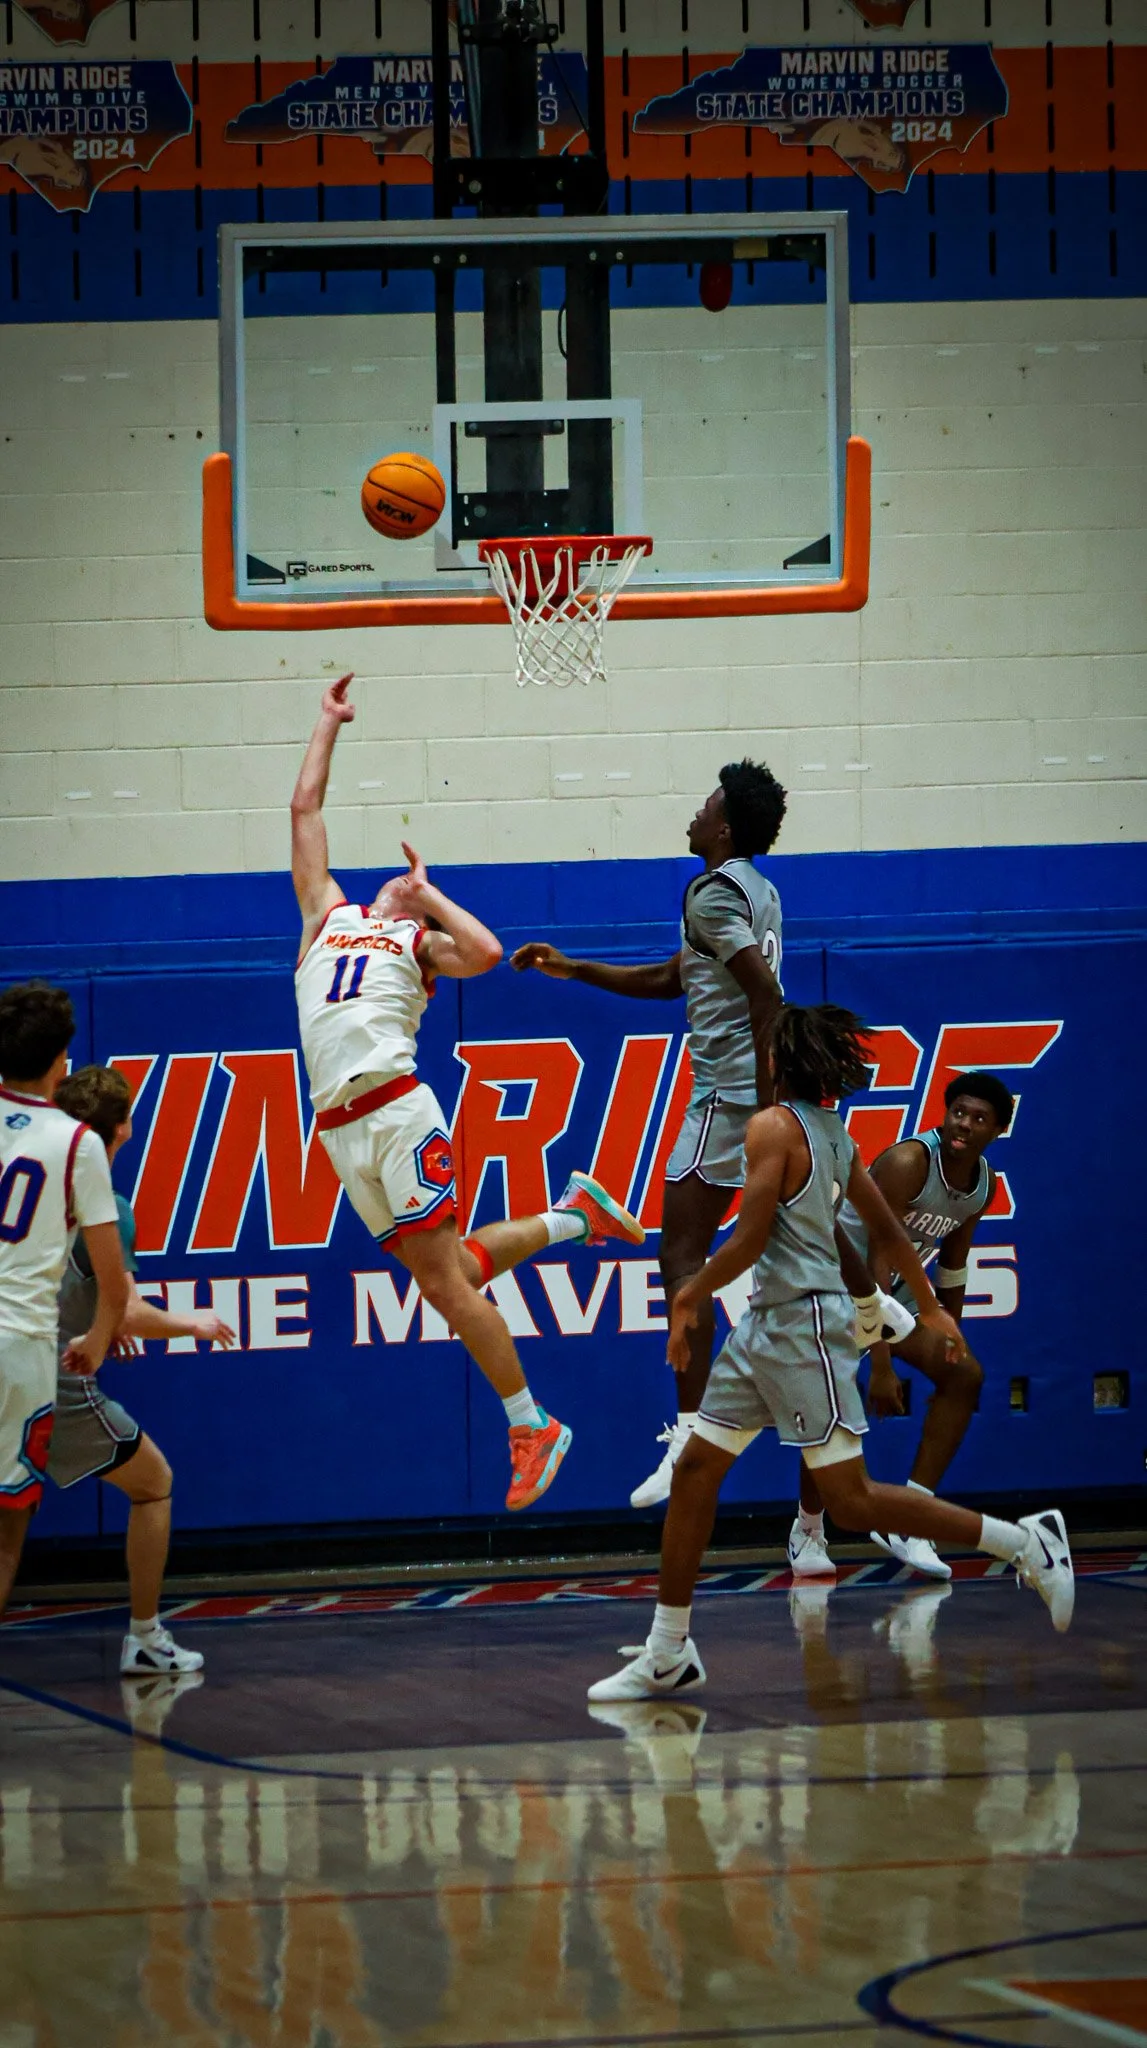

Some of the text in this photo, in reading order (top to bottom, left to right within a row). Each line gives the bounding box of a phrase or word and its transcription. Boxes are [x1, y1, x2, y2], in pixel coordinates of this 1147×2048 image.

[780, 48, 948, 75] MARVIN RIDGE
[63, 65, 132, 90] RIDGE
[767, 74, 964, 91] WOMEN'S SOCCER
[72, 91, 82, 105] &
[96, 91, 146, 105] DIVE
[335, 84, 404, 100] MEN'S
[288, 101, 378, 130] STATE
[696, 90, 965, 121] STATE CHAMPIONS
[891, 120, 953, 143] 2024
[72, 138, 136, 160] 2024
[308, 564, 338, 573] GARED
[322, 934, 403, 956] MAVERICKS
[326, 955, 370, 1003] 11
